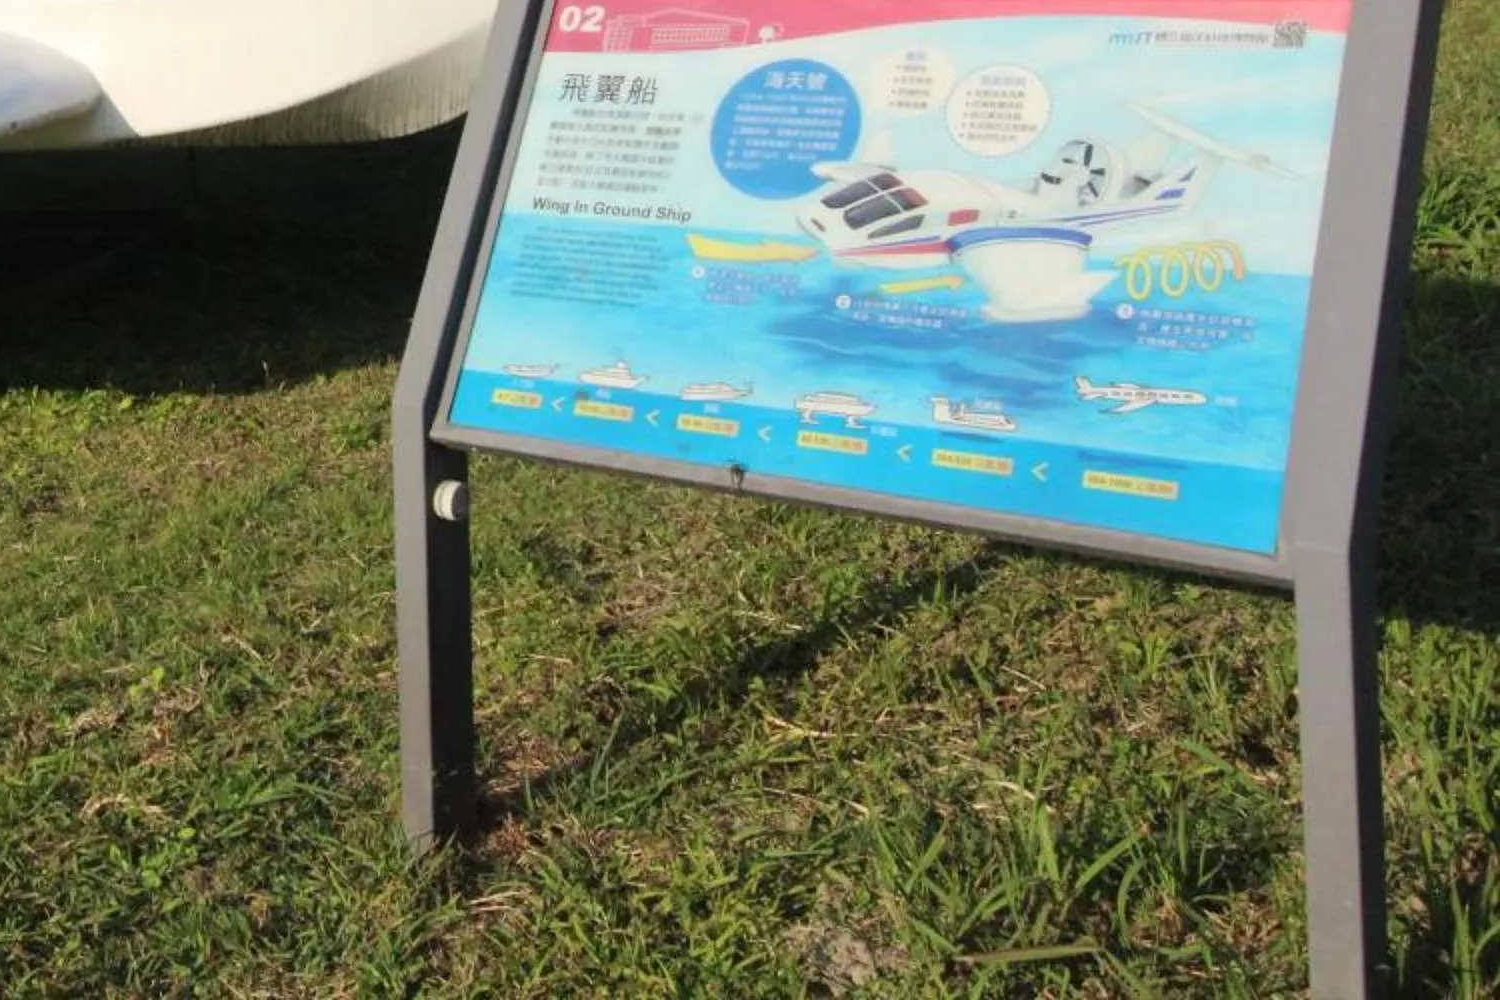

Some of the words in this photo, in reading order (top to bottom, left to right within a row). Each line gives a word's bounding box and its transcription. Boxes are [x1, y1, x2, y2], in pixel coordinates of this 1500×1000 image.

[559, 5, 605, 32] 02
[558, 73, 659, 105] 飛翼船
[533, 197, 571, 215] Wing
[593, 201, 652, 218] Ground
[657, 205, 692, 225] Ship
